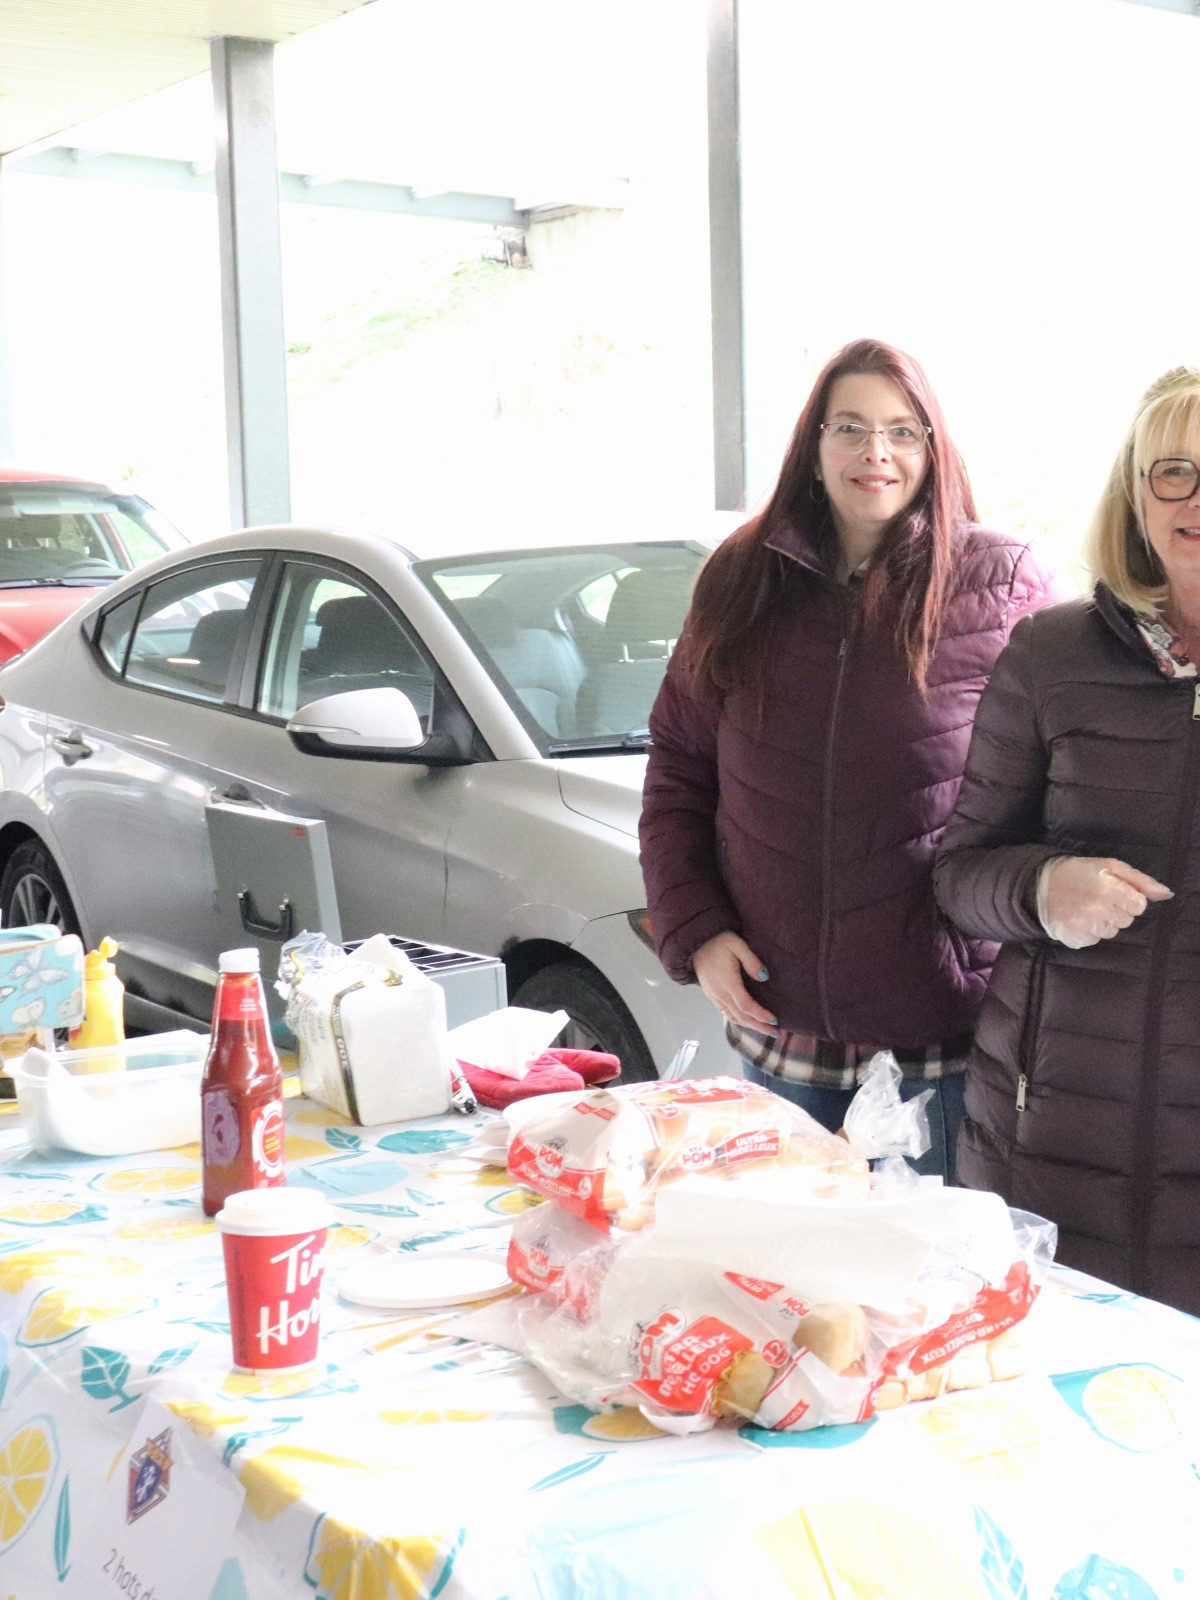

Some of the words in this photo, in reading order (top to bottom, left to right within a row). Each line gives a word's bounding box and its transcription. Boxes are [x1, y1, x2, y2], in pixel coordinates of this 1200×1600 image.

[682, 1151, 712, 1165] POM
[782, 1296, 810, 1317] POM
[699, 1346, 731, 1374] DOG
[763, 1340, 782, 1361] 12
[103, 1548, 117, 1573] 2
[112, 1556, 142, 1600] hots
